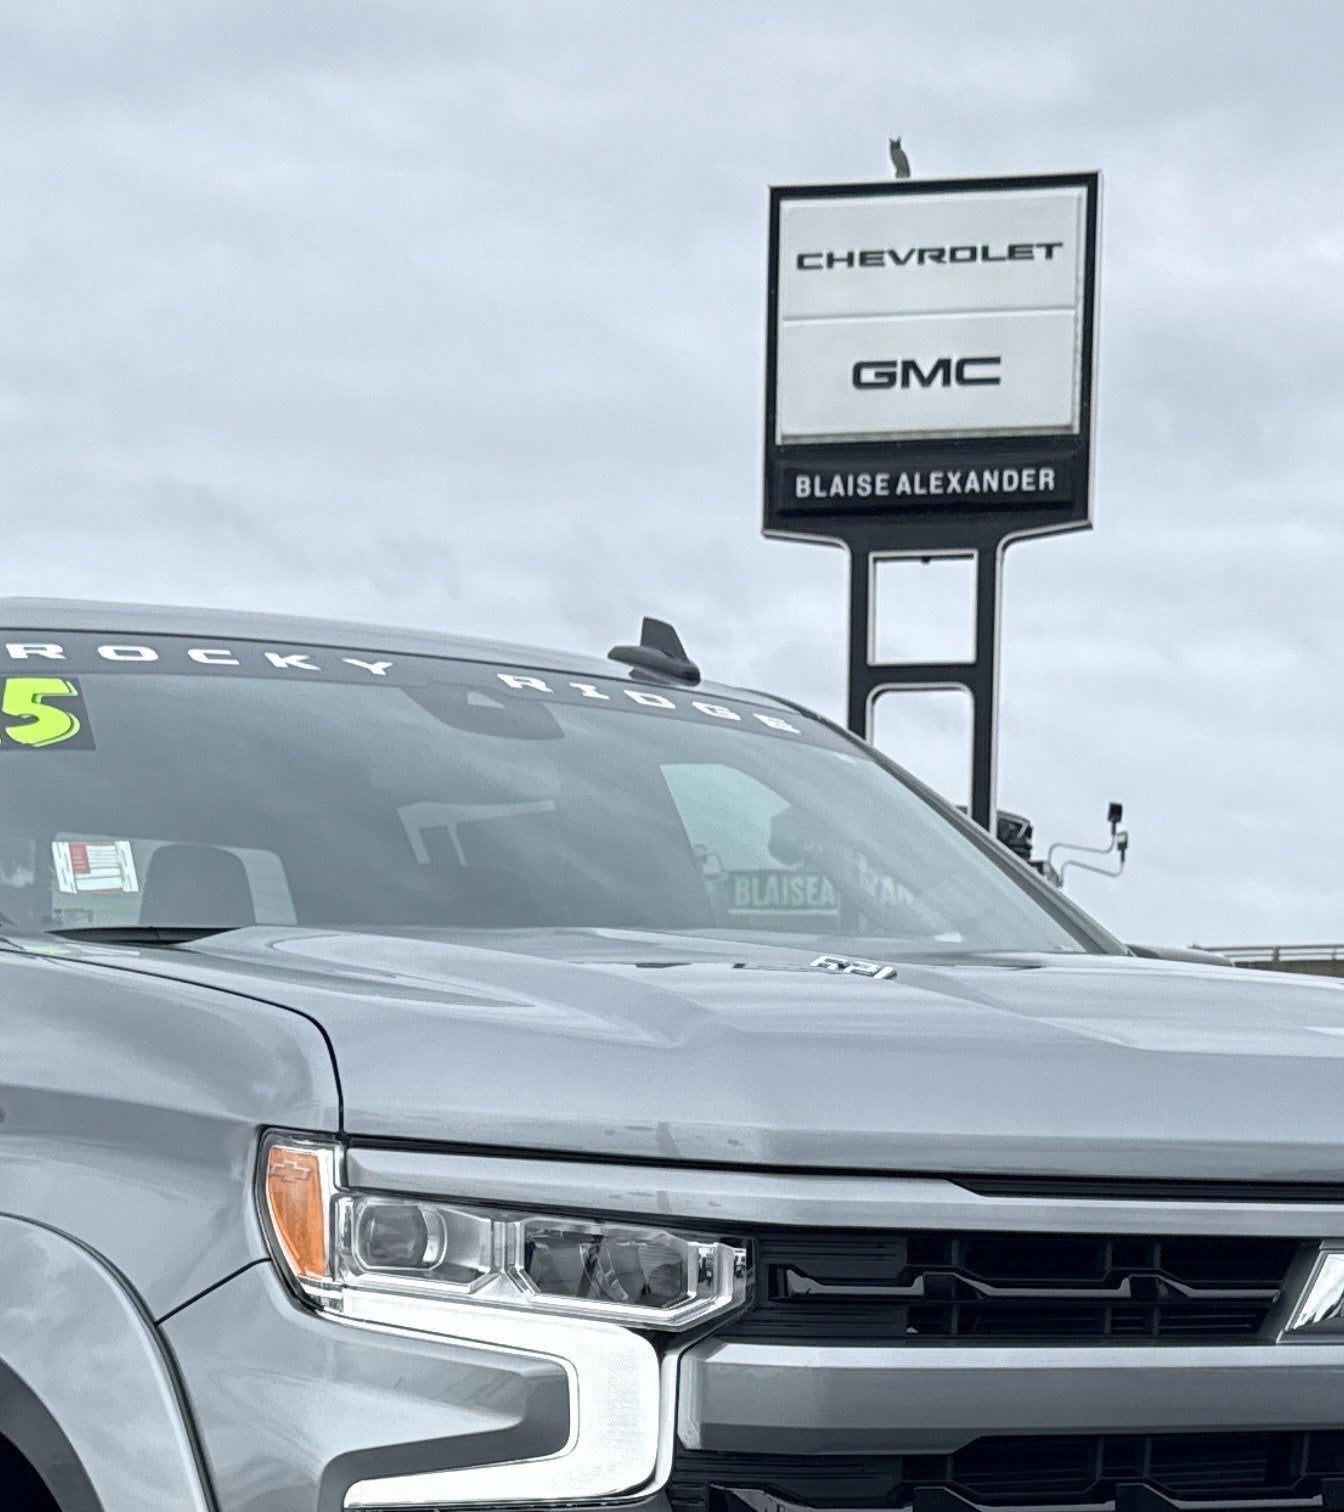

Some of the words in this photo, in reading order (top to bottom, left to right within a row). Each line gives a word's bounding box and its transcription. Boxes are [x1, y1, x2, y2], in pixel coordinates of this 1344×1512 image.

[796, 241, 1064, 271] CHEVROLET
[852, 356, 1002, 391] GMC
[796, 473, 890, 498] BLAISE
[896, 466, 1055, 496] ALEXANDER
[5, 642, 394, 677] ROCKY
[496, 673, 802, 734] RIDGE
